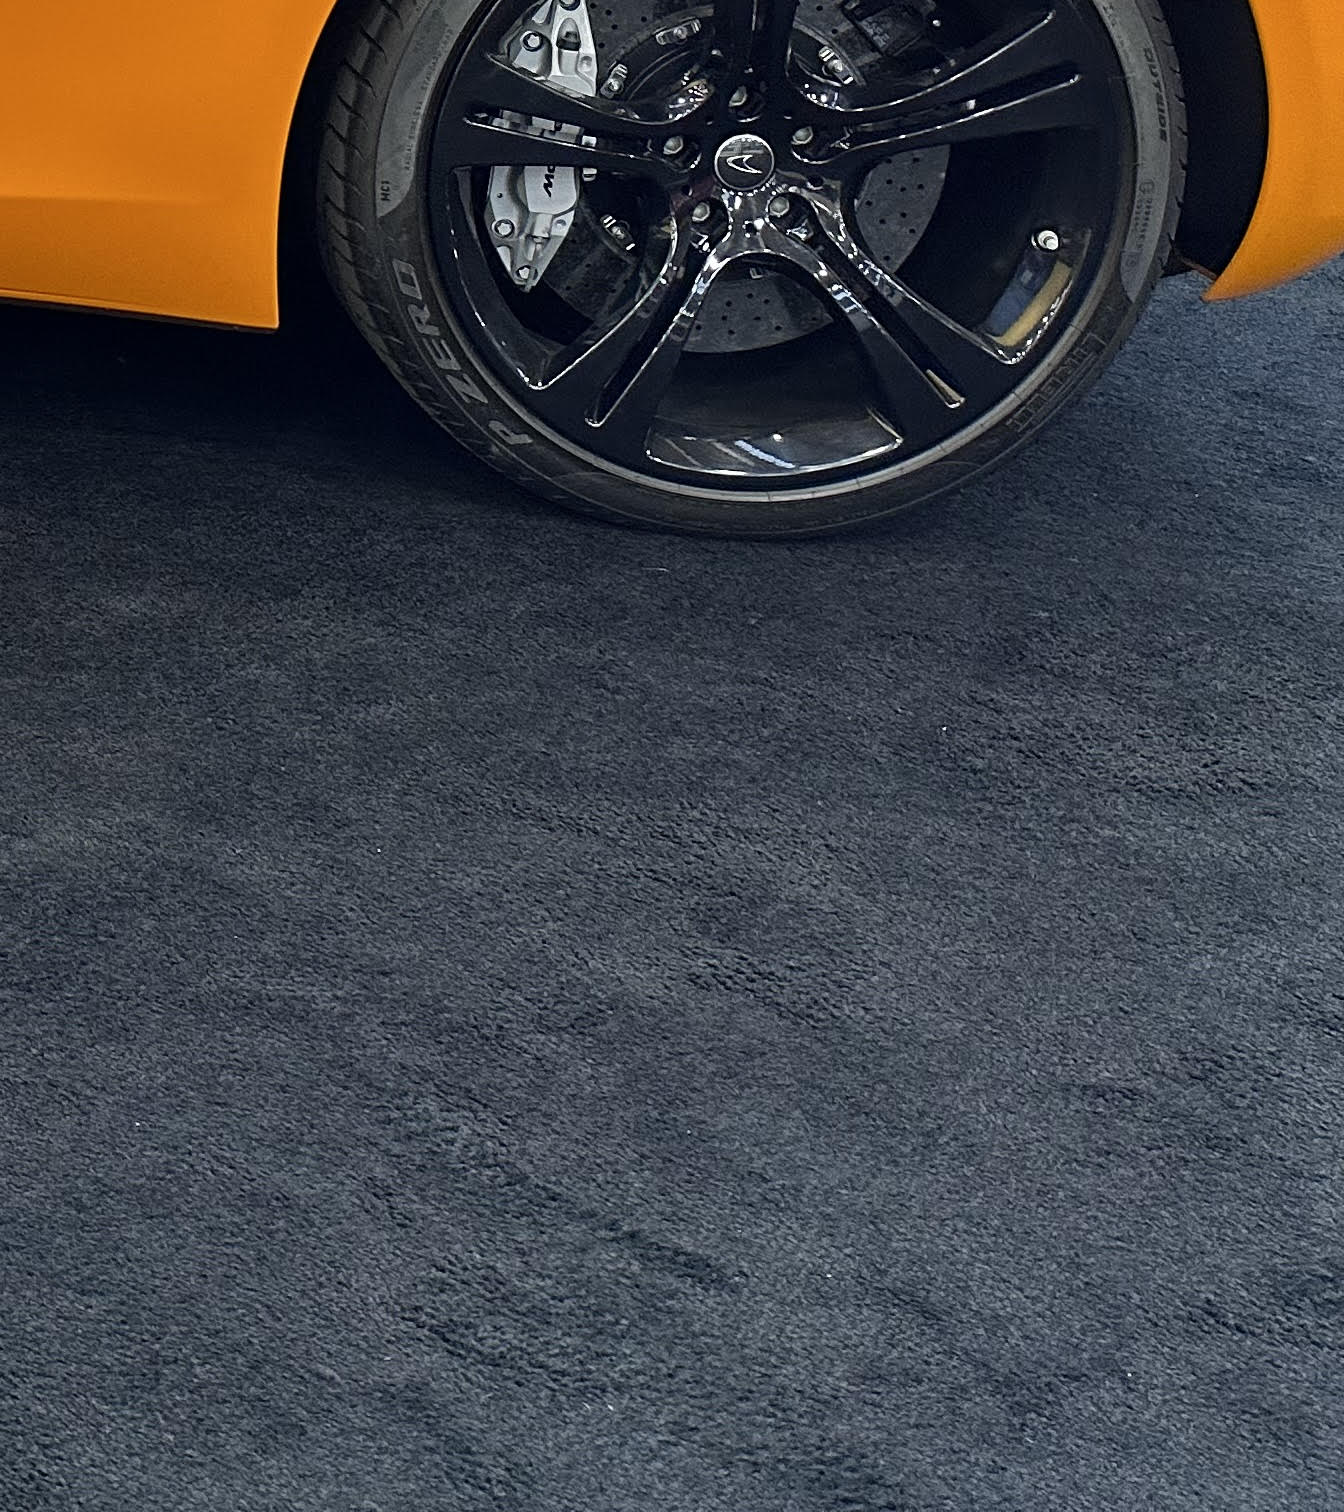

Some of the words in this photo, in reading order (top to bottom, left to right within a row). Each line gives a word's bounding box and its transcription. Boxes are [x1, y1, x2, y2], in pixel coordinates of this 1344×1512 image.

[1142, 46, 1168, 143] OUTSIDE
[392, 258, 489, 404] ZERO
[487, 419, 534, 445] P
